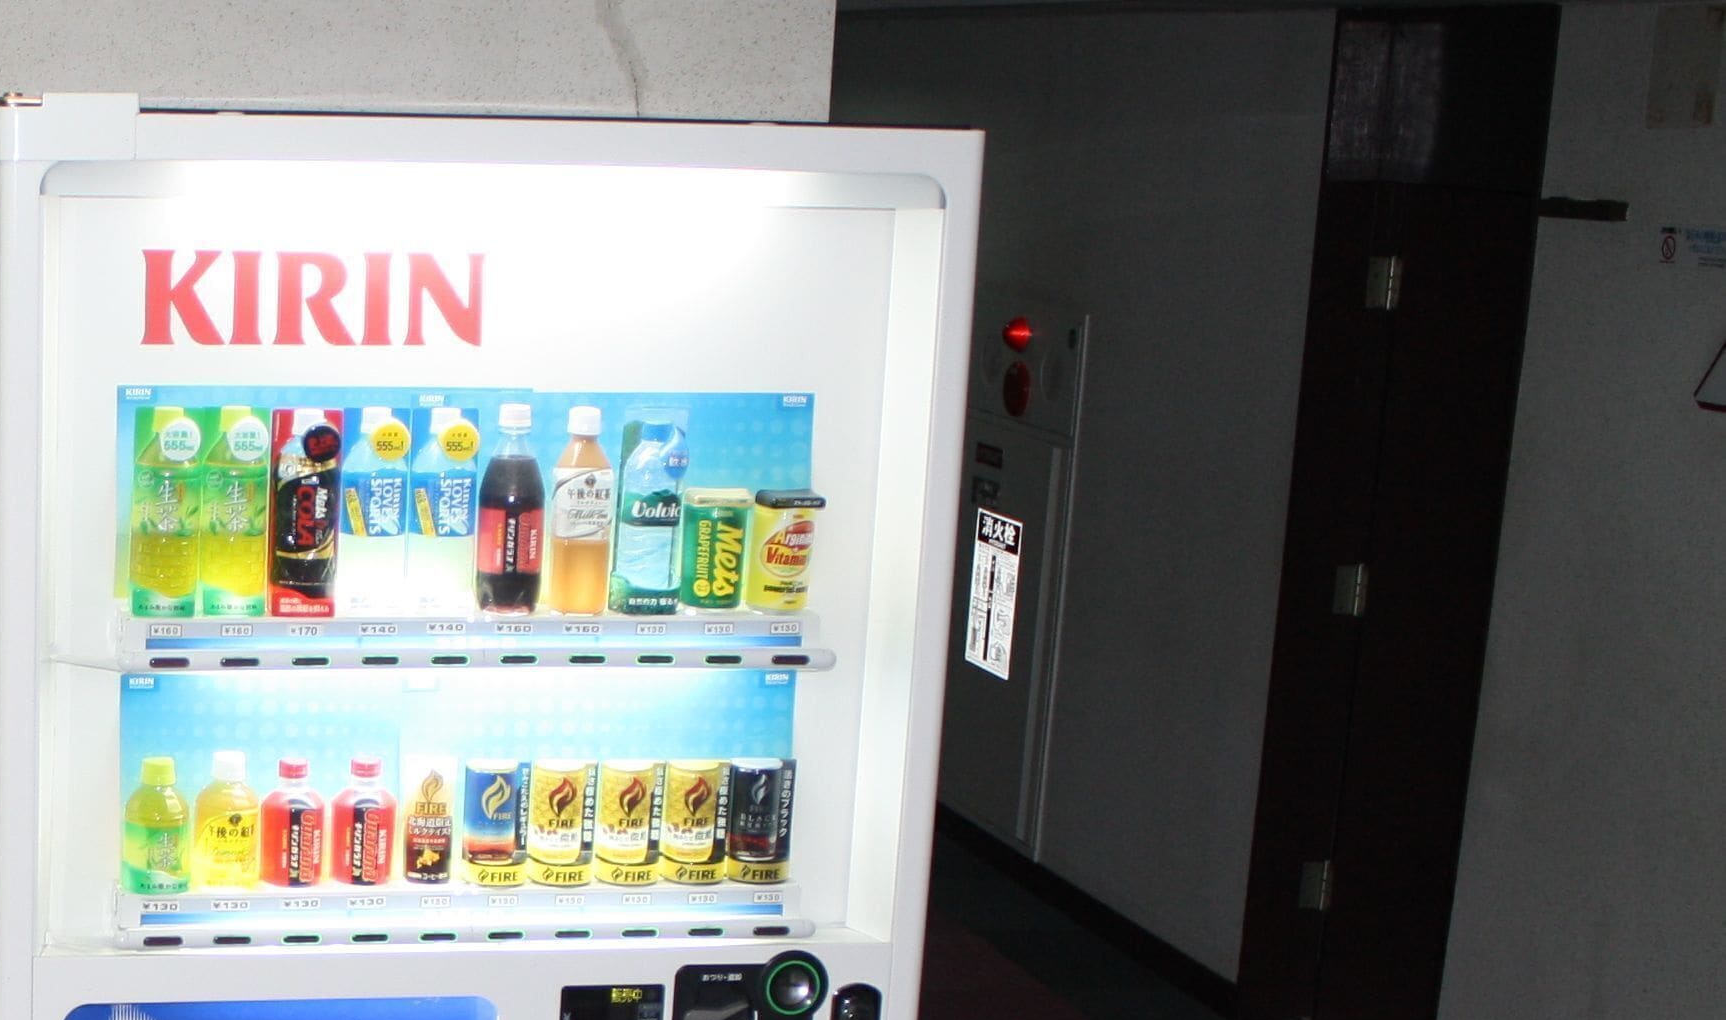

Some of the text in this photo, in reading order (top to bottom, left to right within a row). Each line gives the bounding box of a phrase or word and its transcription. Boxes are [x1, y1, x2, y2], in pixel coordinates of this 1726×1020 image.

[140, 249, 485, 347] KIRIN
[567, 487, 611, 500] 午後の紅茶
[156, 479, 179, 531] 生茶
[225, 479, 248, 532] 生茶
[631, 500, 681, 518] Volvic
[296, 486, 315, 545] COLA
[981, 515, 1016, 546] 消火栓
[529, 529, 537, 560] KIRIN
[696, 520, 712, 580] GRAPEFRUIT
[712, 522, 744, 597] Mets
[291, 626, 318, 635] ¥170
[415, 801, 447, 815] FIRE
[494, 812, 512, 820] FIRE
[683, 818, 708, 827] FIRE
[549, 819, 574, 828] FIRE
[618, 818, 644, 828] FIRE
[491, 872, 518, 882] FIRE
[555, 871, 584, 882] FIRE
[624, 870, 652, 881] FIRE
[688, 869, 716, 880] FIRE
[751, 869, 780, 880] FIRE
[142, 903, 178, 911] ¥130
[213, 901, 249, 909] ¥130
[284, 900, 319, 908] ¥130
[349, 898, 384, 906] ¥130
